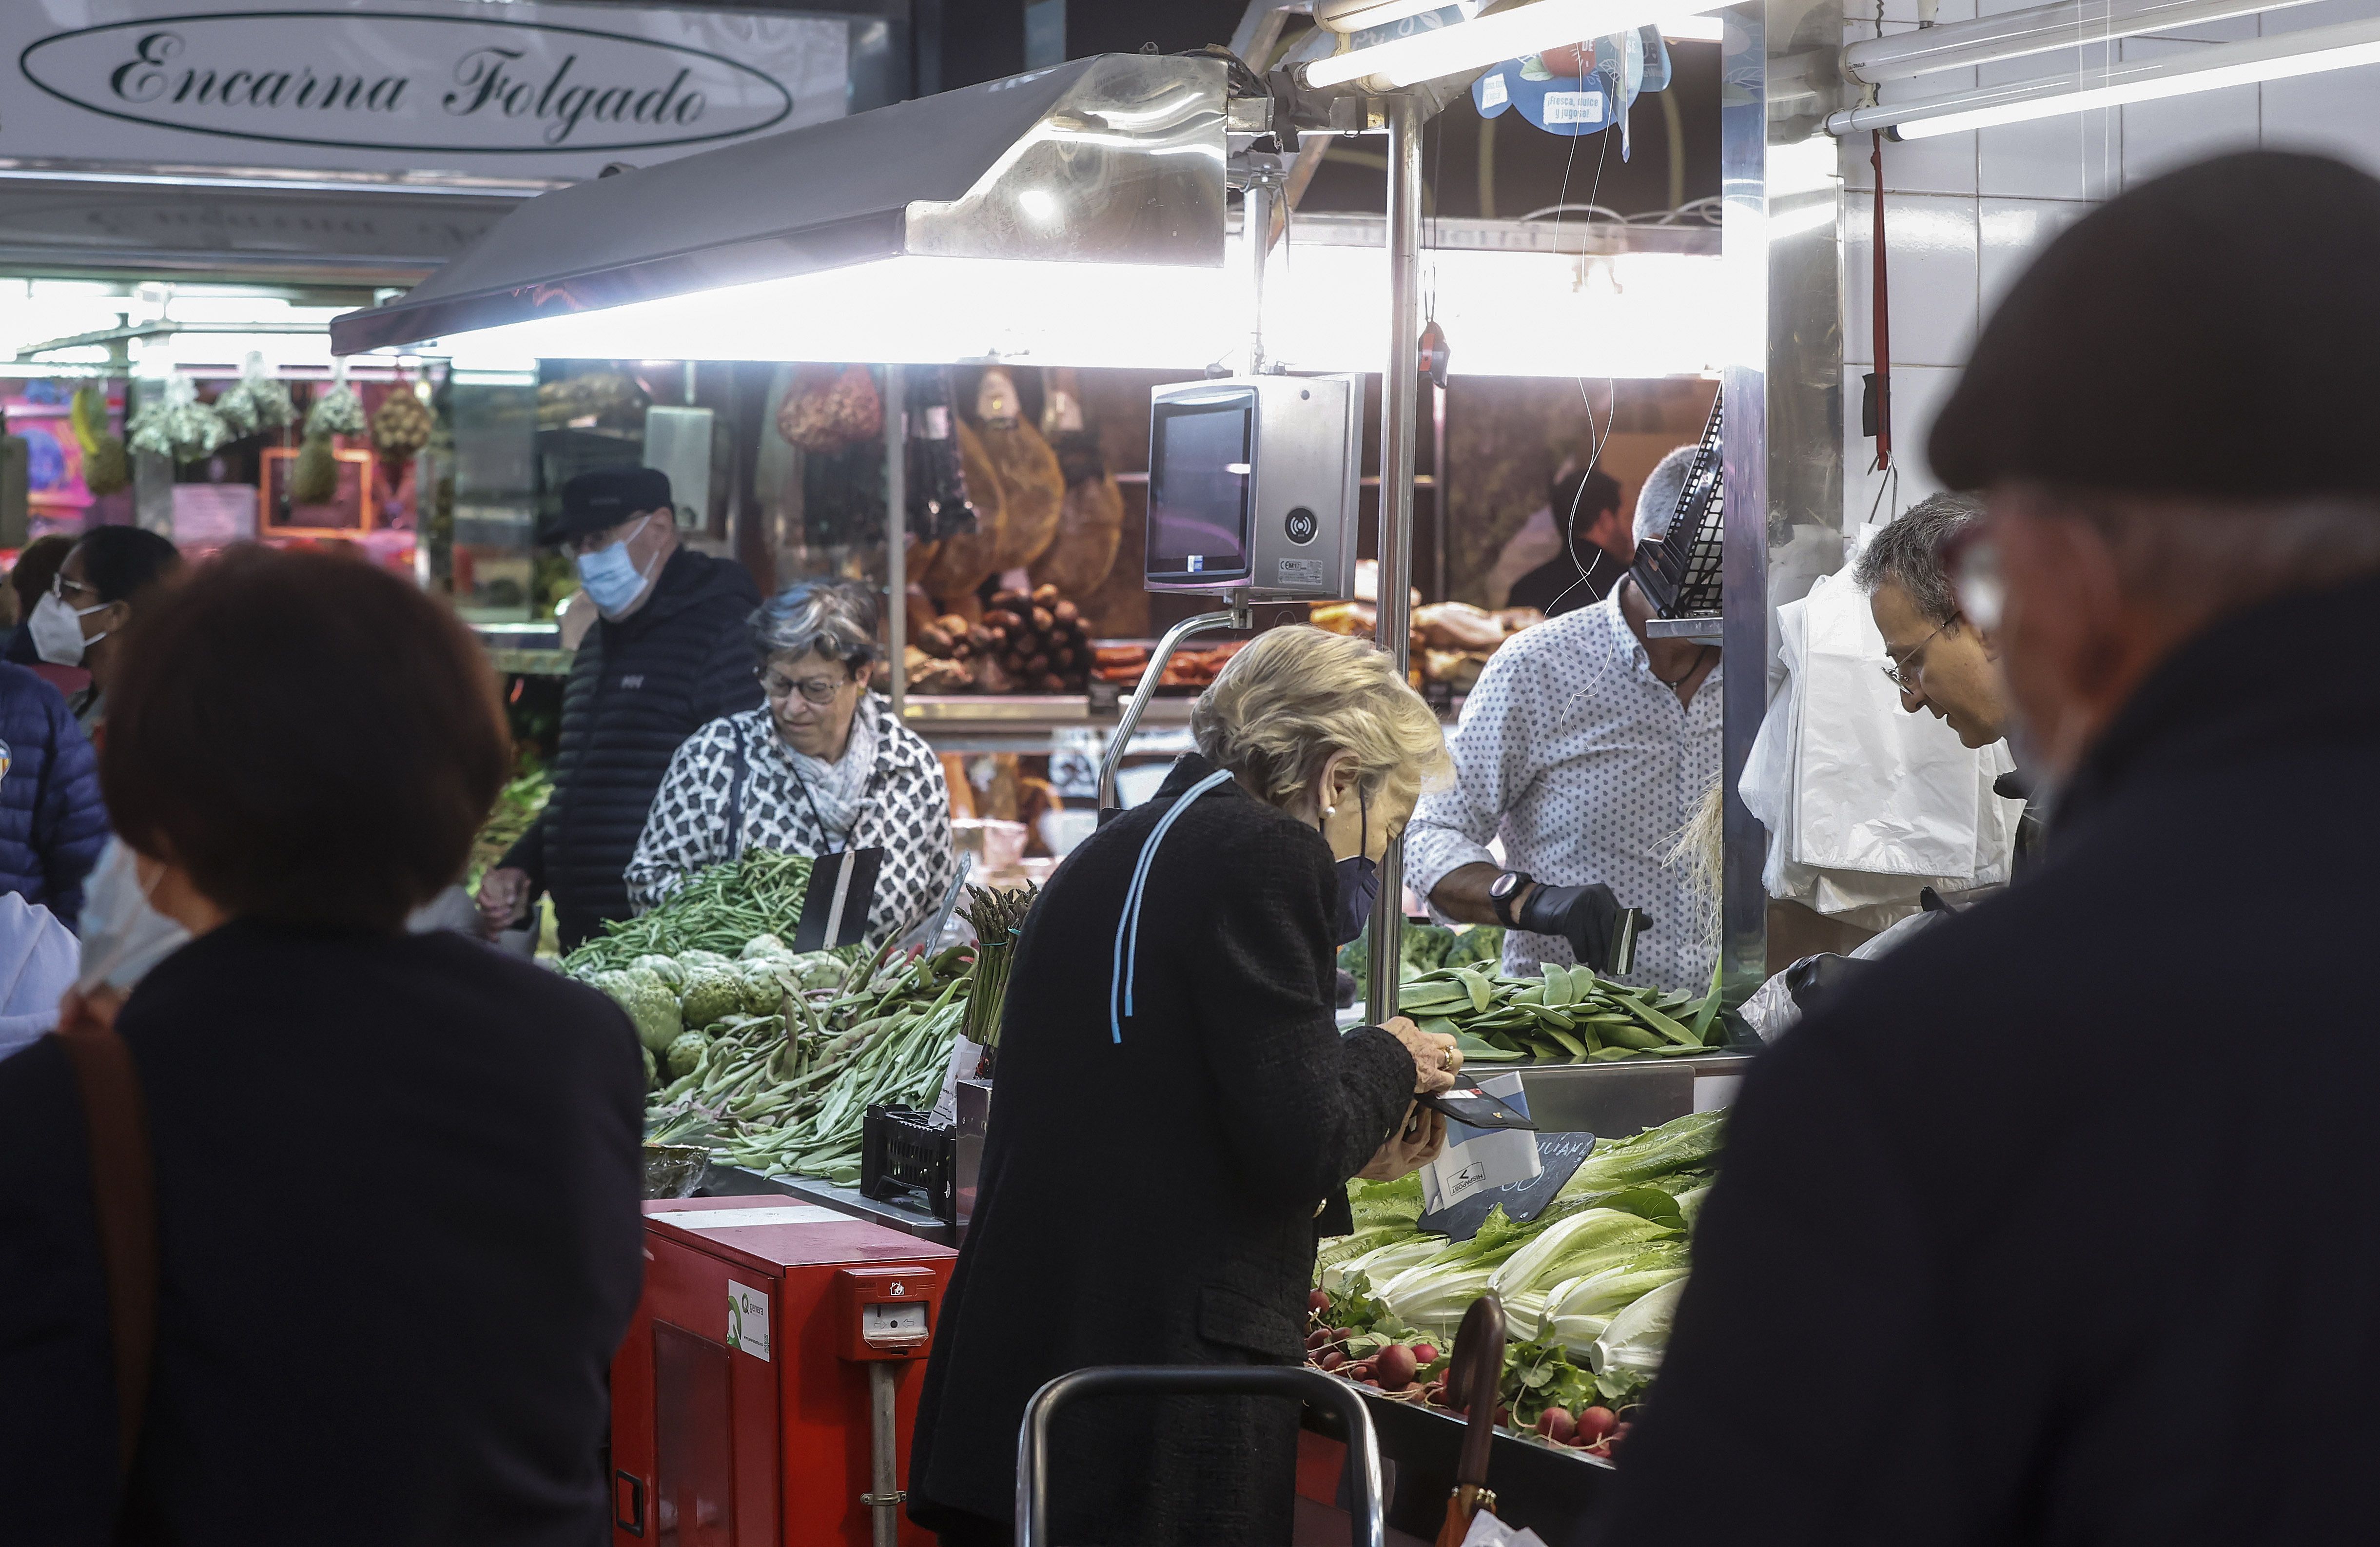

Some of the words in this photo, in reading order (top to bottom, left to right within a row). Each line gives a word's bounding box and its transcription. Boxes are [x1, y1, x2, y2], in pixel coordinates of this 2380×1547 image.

[110, 31, 410, 112] Encarna
[443, 46, 706, 144] Folgado
[1452, 1174, 1483, 1194] HISPAPOST
[749, 1303, 763, 1315] genera
